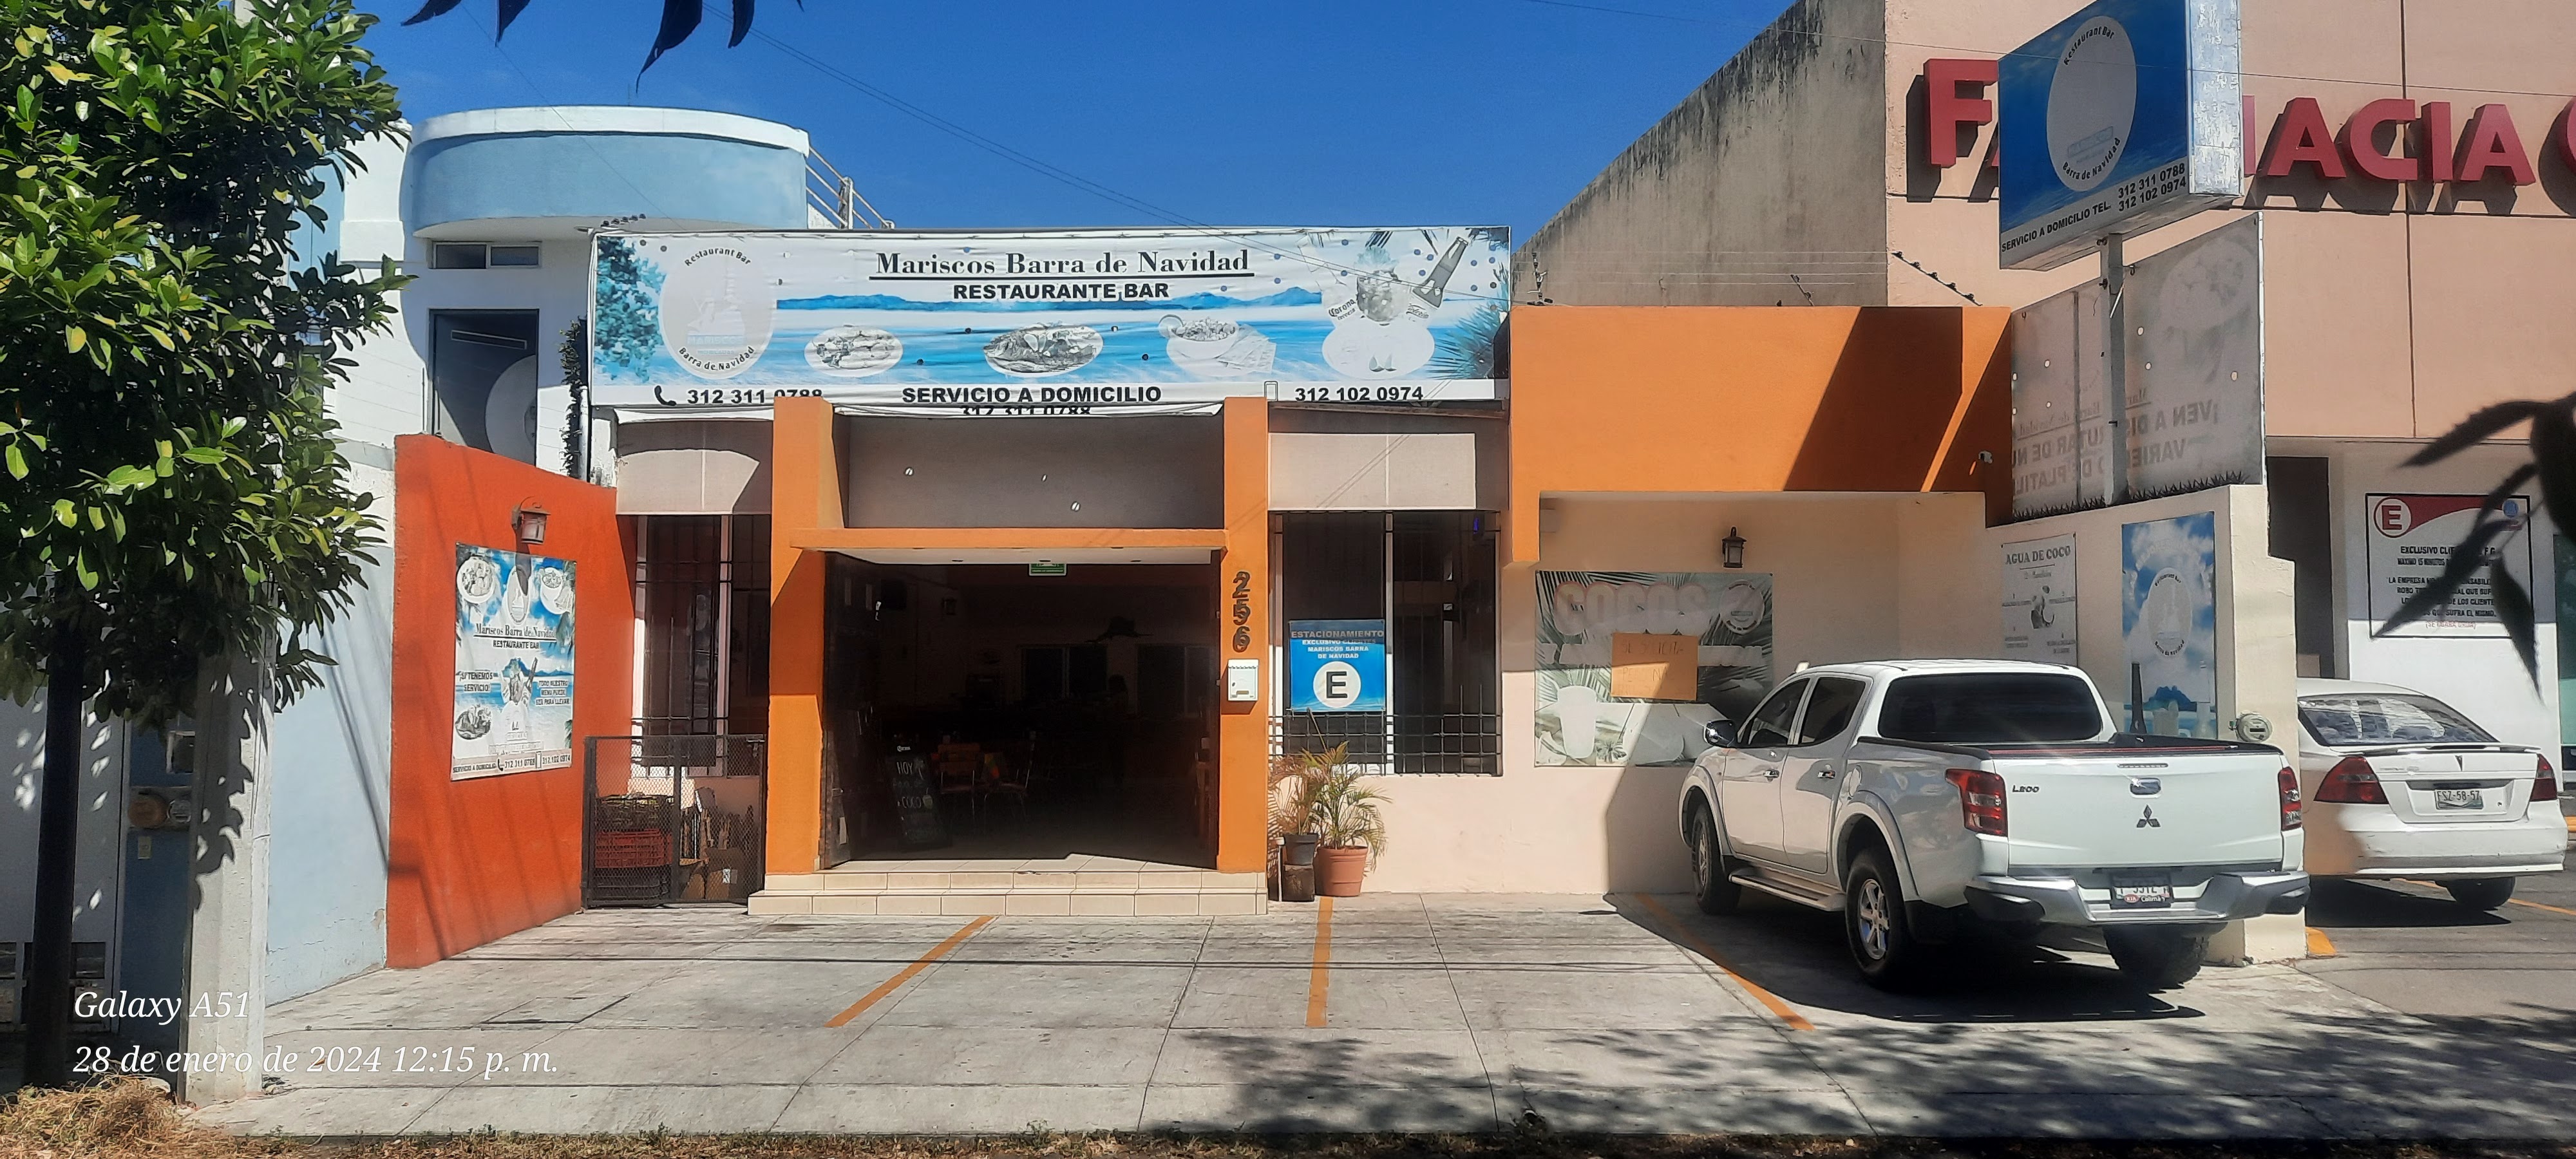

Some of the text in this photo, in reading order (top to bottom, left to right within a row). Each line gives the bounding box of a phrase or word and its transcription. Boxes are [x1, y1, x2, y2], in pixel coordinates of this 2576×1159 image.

[2063, 25, 2114, 66] Restaurant Bar
[2063, 162, 2079, 180] Barra
[2081, 170, 2090, 180] de
[2092, 137, 2121, 177] Navidad
[2118, 162, 2185, 199] 312 311 0788
[2119, 176, 2186, 212] 312 102 0974
[2002, 228, 2037, 252] SERVICIO
[2039, 227, 2045, 237] A
[2047, 208, 2090, 234] DOMICILIO
[685, 248, 751, 267] Restaurant Bar
[876, 249, 1248, 274] Mariscos Barra de Navidad
[953, 283, 1170, 299] RESTAURANTE BAR
[1328, 298, 1357, 317] Corona
[679, 346, 755, 371] Barra de Navidad
[687, 389, 724, 404] 312
[730, 389, 765, 404] 311
[902, 386, 1161, 403] SERVICIO A DOMICILIO
[1294, 386, 1423, 401] 312 102 0974
[2381, 505, 2403, 531] E
[2005, 545, 2071, 565] AGUA DE COCO
[2400, 546, 2438, 554] EXCLUSIVO
[476, 623, 504, 635] Mariscos
[505, 625, 522, 636] Barra
[524, 626, 531, 637] de
[493, 640, 529, 649] RESTAURANTE
[1326, 671, 1347, 699] E
[896, 761, 913, 774] HOY
